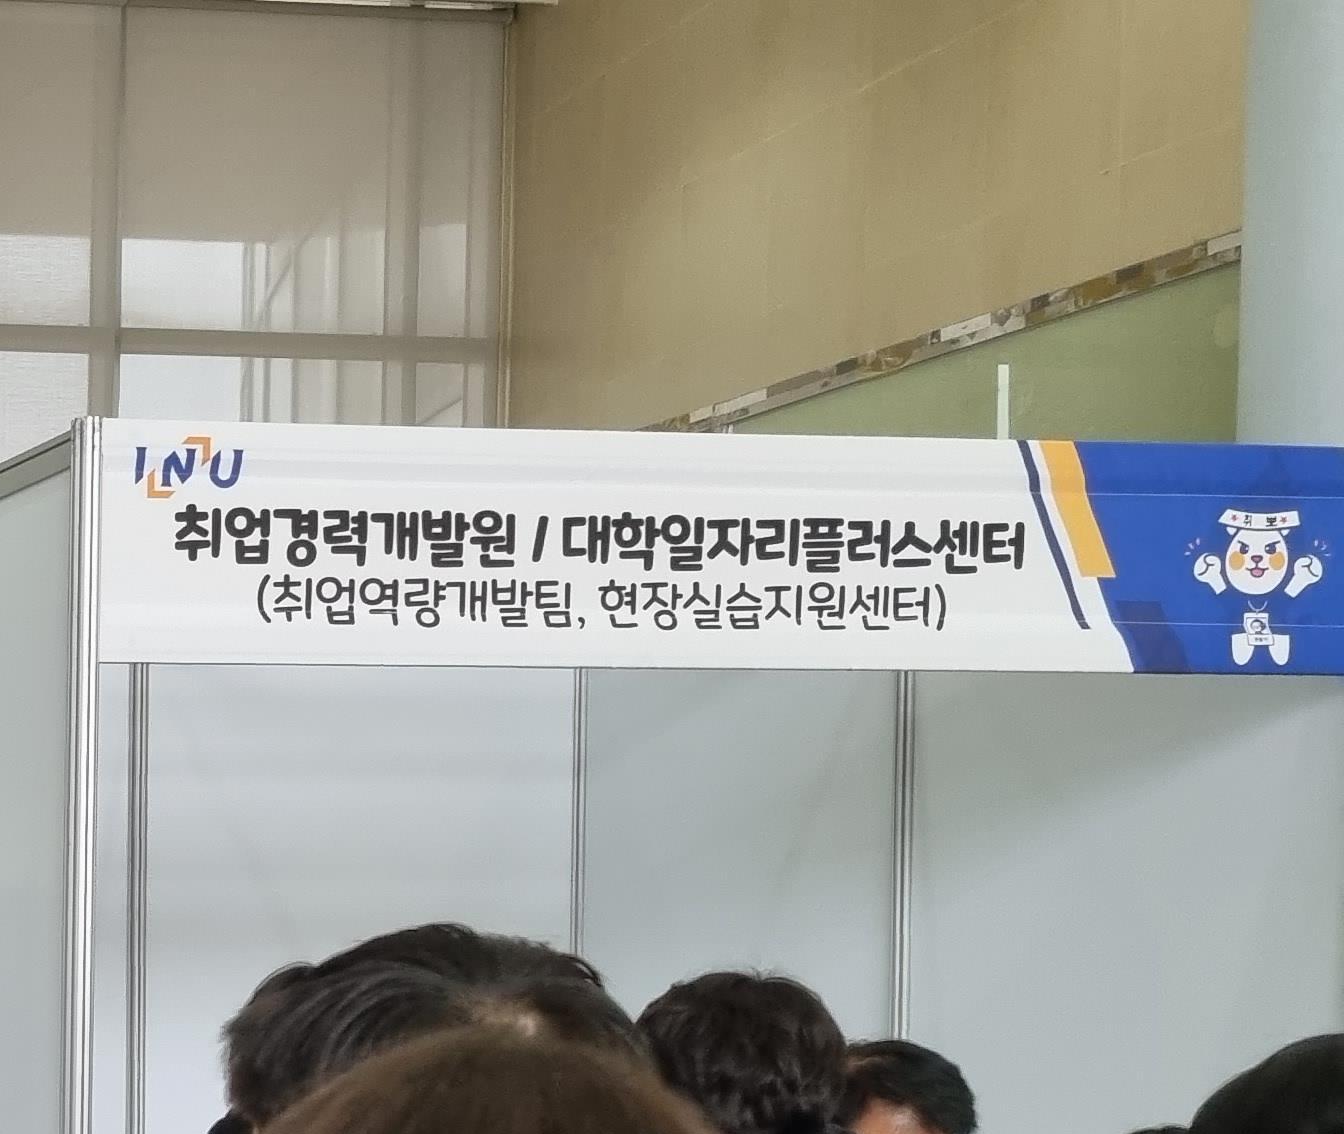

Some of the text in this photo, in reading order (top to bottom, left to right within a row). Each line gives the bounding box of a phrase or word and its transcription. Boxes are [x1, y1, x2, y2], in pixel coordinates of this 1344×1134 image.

[134, 445, 244, 490] INU
[174, 504, 1026, 574] 취업경력개발원 / 대학일자리플러스센터
[257, 573, 947, 631] (취업역량개발팀, 현장실습지원센터)
